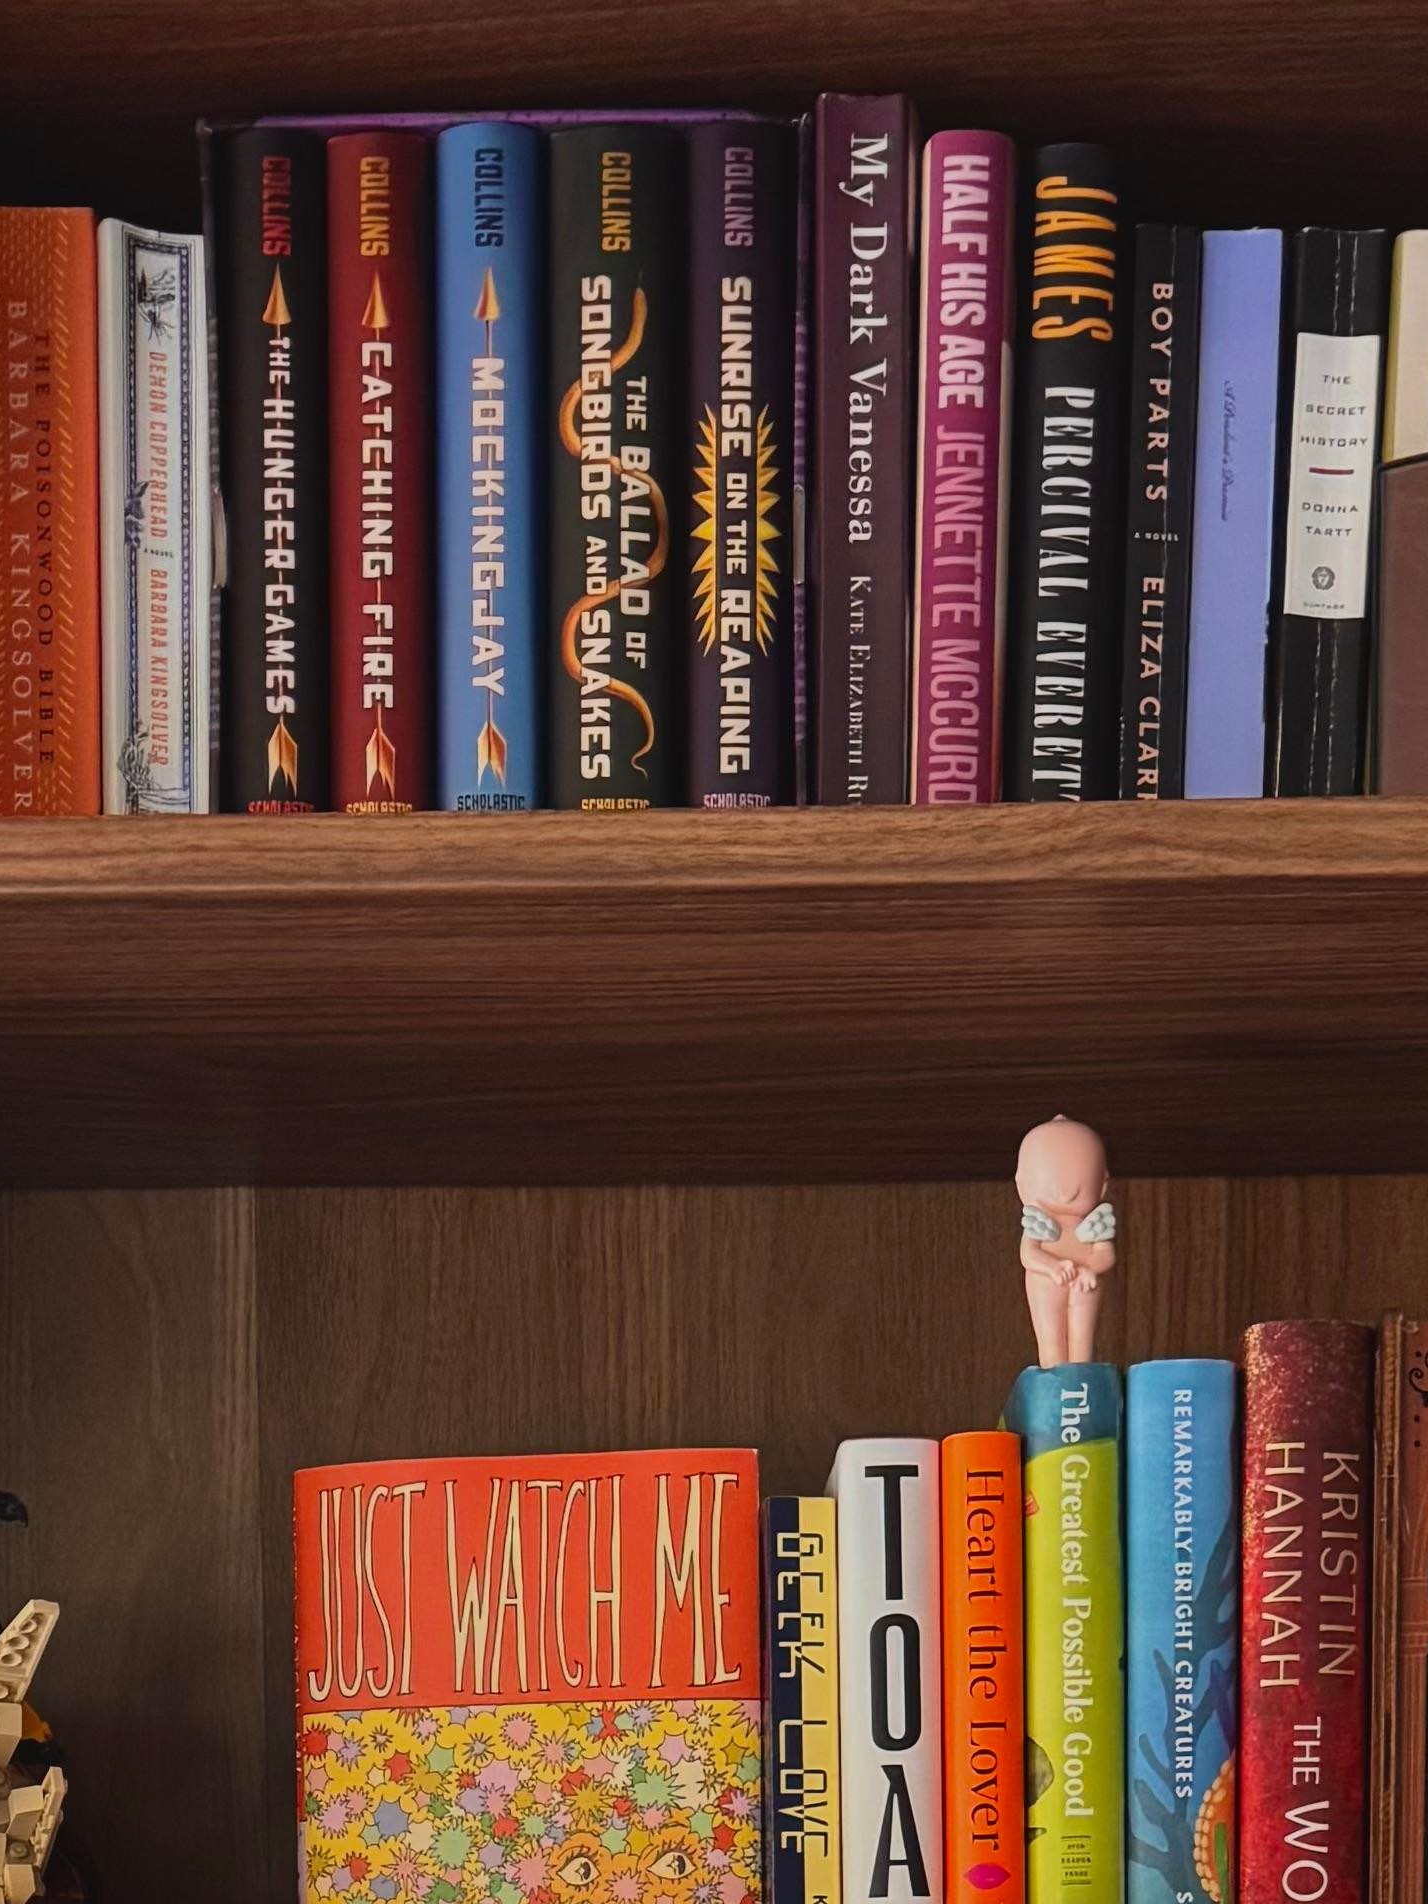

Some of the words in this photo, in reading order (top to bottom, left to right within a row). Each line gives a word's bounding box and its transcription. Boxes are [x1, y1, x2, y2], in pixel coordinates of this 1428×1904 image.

[838, 134, 889, 206] My
[848, 222, 888, 344] Dark
[269, 338, 290, 382] THE
[580, 275, 613, 519] SONGBIRDS
[720, 276, 752, 456] SUNRISE
[1306, 405, 1366, 416] SECRET
[1322, 374, 1351, 384] THE
[263, 399, 294, 569] HUNGER
[360, 342, 392, 580] CATCHING
[726, 472, 746, 504] ON
[848, 359, 886, 542] Vanessa
[1300, 435, 1368, 448] HISTORY
[472, 359, 504, 695] MOCKINGJAY
[587, 536, 606, 594] AND
[726, 522, 746, 575] THE
[1302, 504, 1358, 514] DONNA
[1304, 526, 1353, 536] TARTT
[264, 584, 295, 714] GAMES
[363, 605, 394, 709] FIRE
[580, 609, 611, 779] SNAKES
[719, 589, 751, 774] REAPING
[310, 1479, 424, 1701] JUST
[444, 1474, 621, 1696] WATCH
[652, 1472, 741, 1689] ME
[1259, 1441, 1305, 1689] HANNAH
[1320, 1451, 1360, 1678] KRISTIN
[1292, 1716, 1323, 1785] THE
